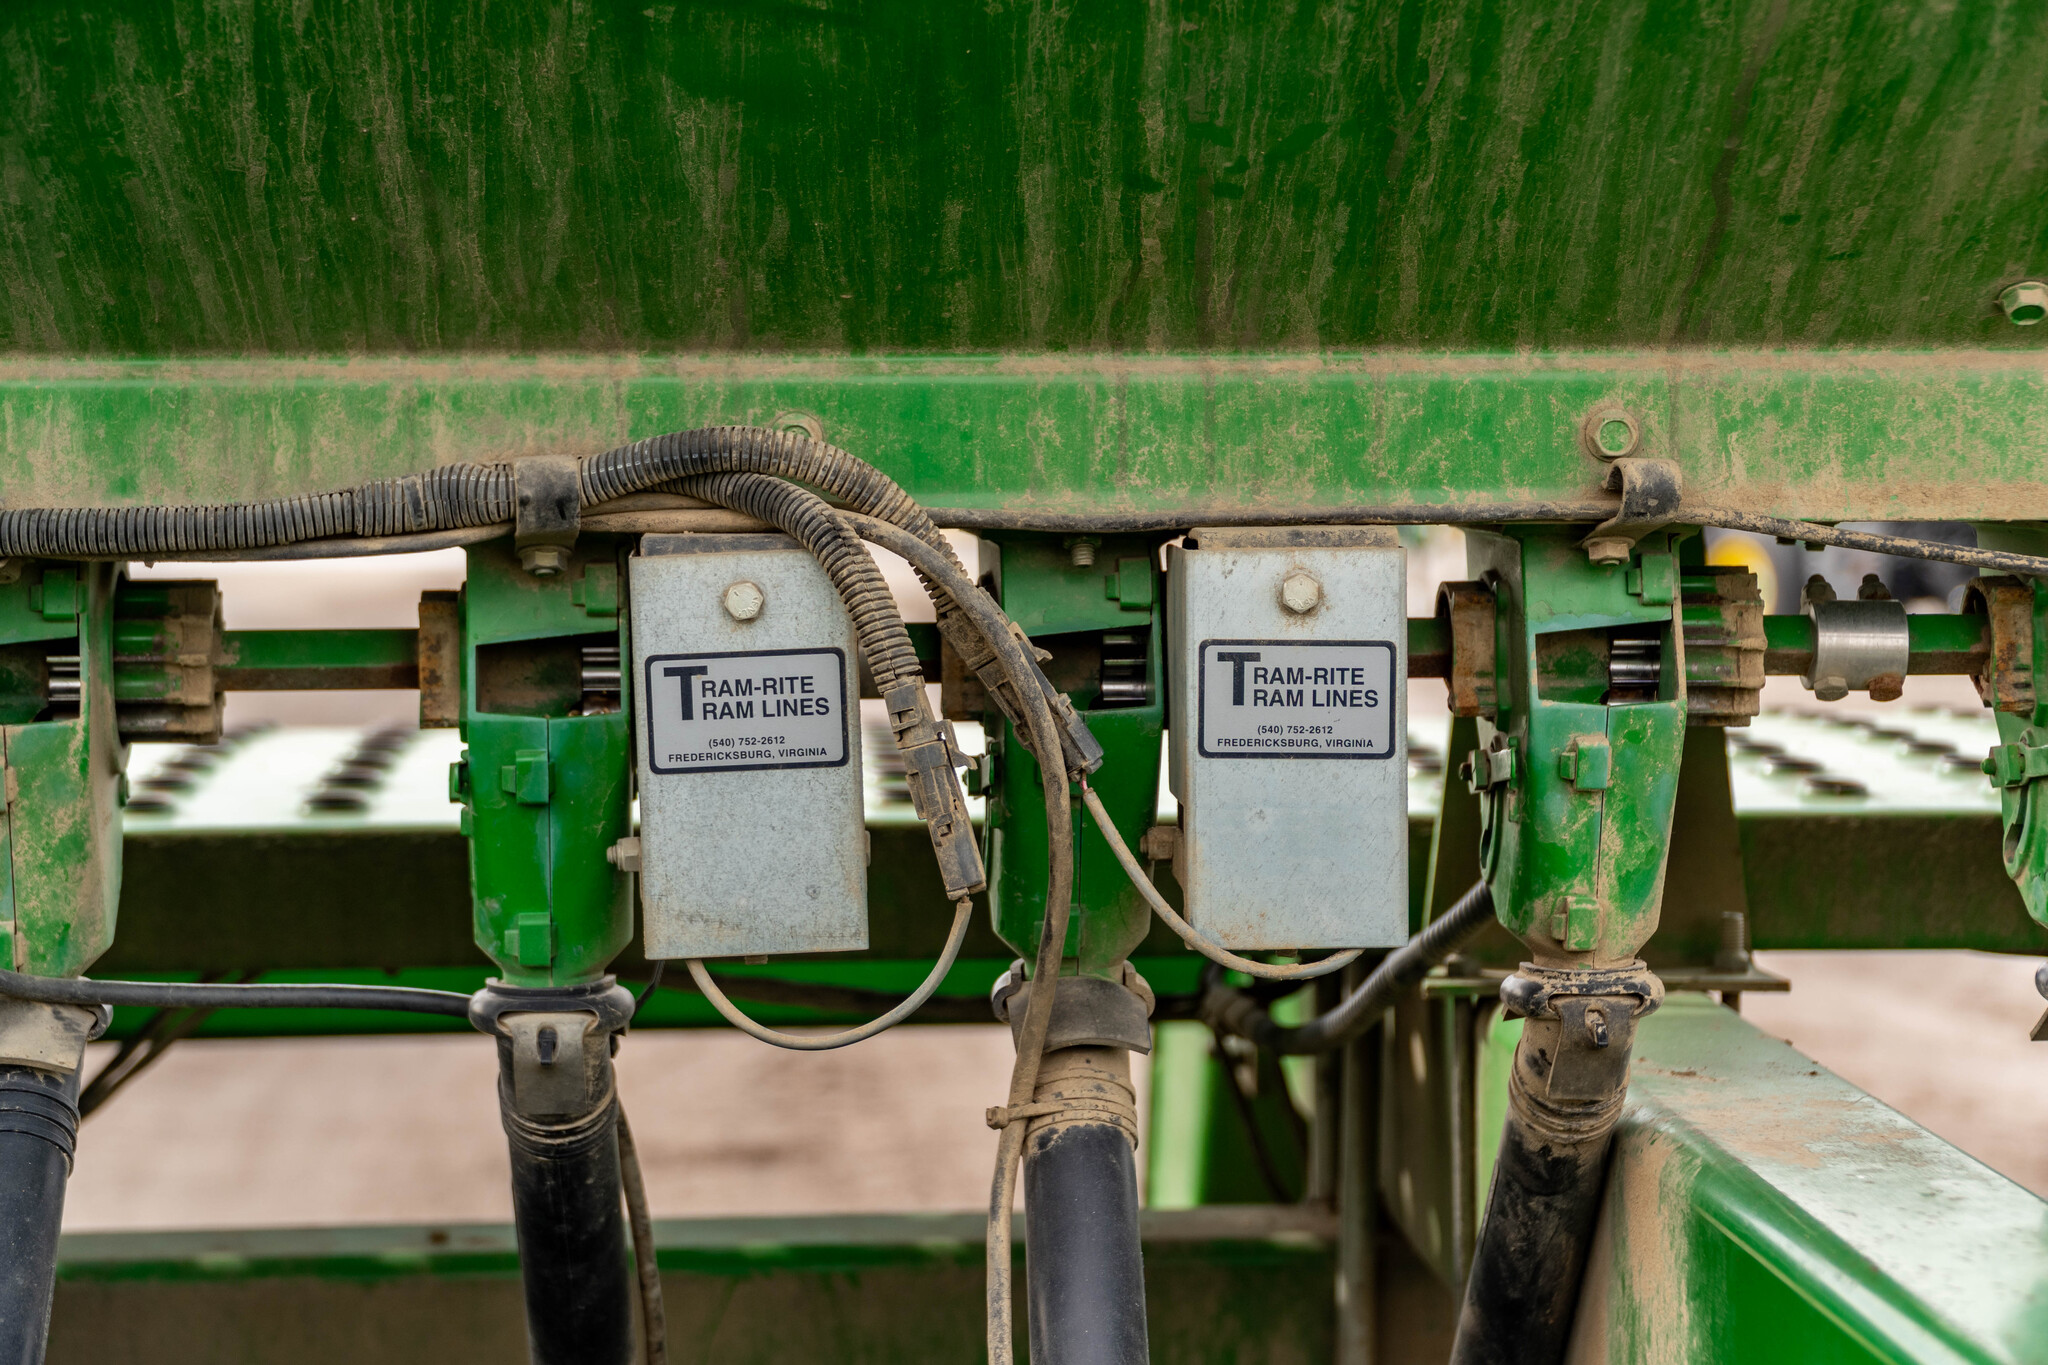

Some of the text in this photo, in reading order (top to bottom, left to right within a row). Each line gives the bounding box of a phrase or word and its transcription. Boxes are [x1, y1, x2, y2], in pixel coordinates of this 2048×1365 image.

[1312, 689, 1379, 708] LINES
[762, 697, 830, 718] LINES
[1257, 725, 1333, 736] (540) 752-2612
[708, 736, 786, 749] (540) 752-2612
[1217, 738, 1374, 749] FREDERICKSBURG, VIRGINIA
[668, 747, 828, 763] FREDERICKSBURG, VIRGINIA
